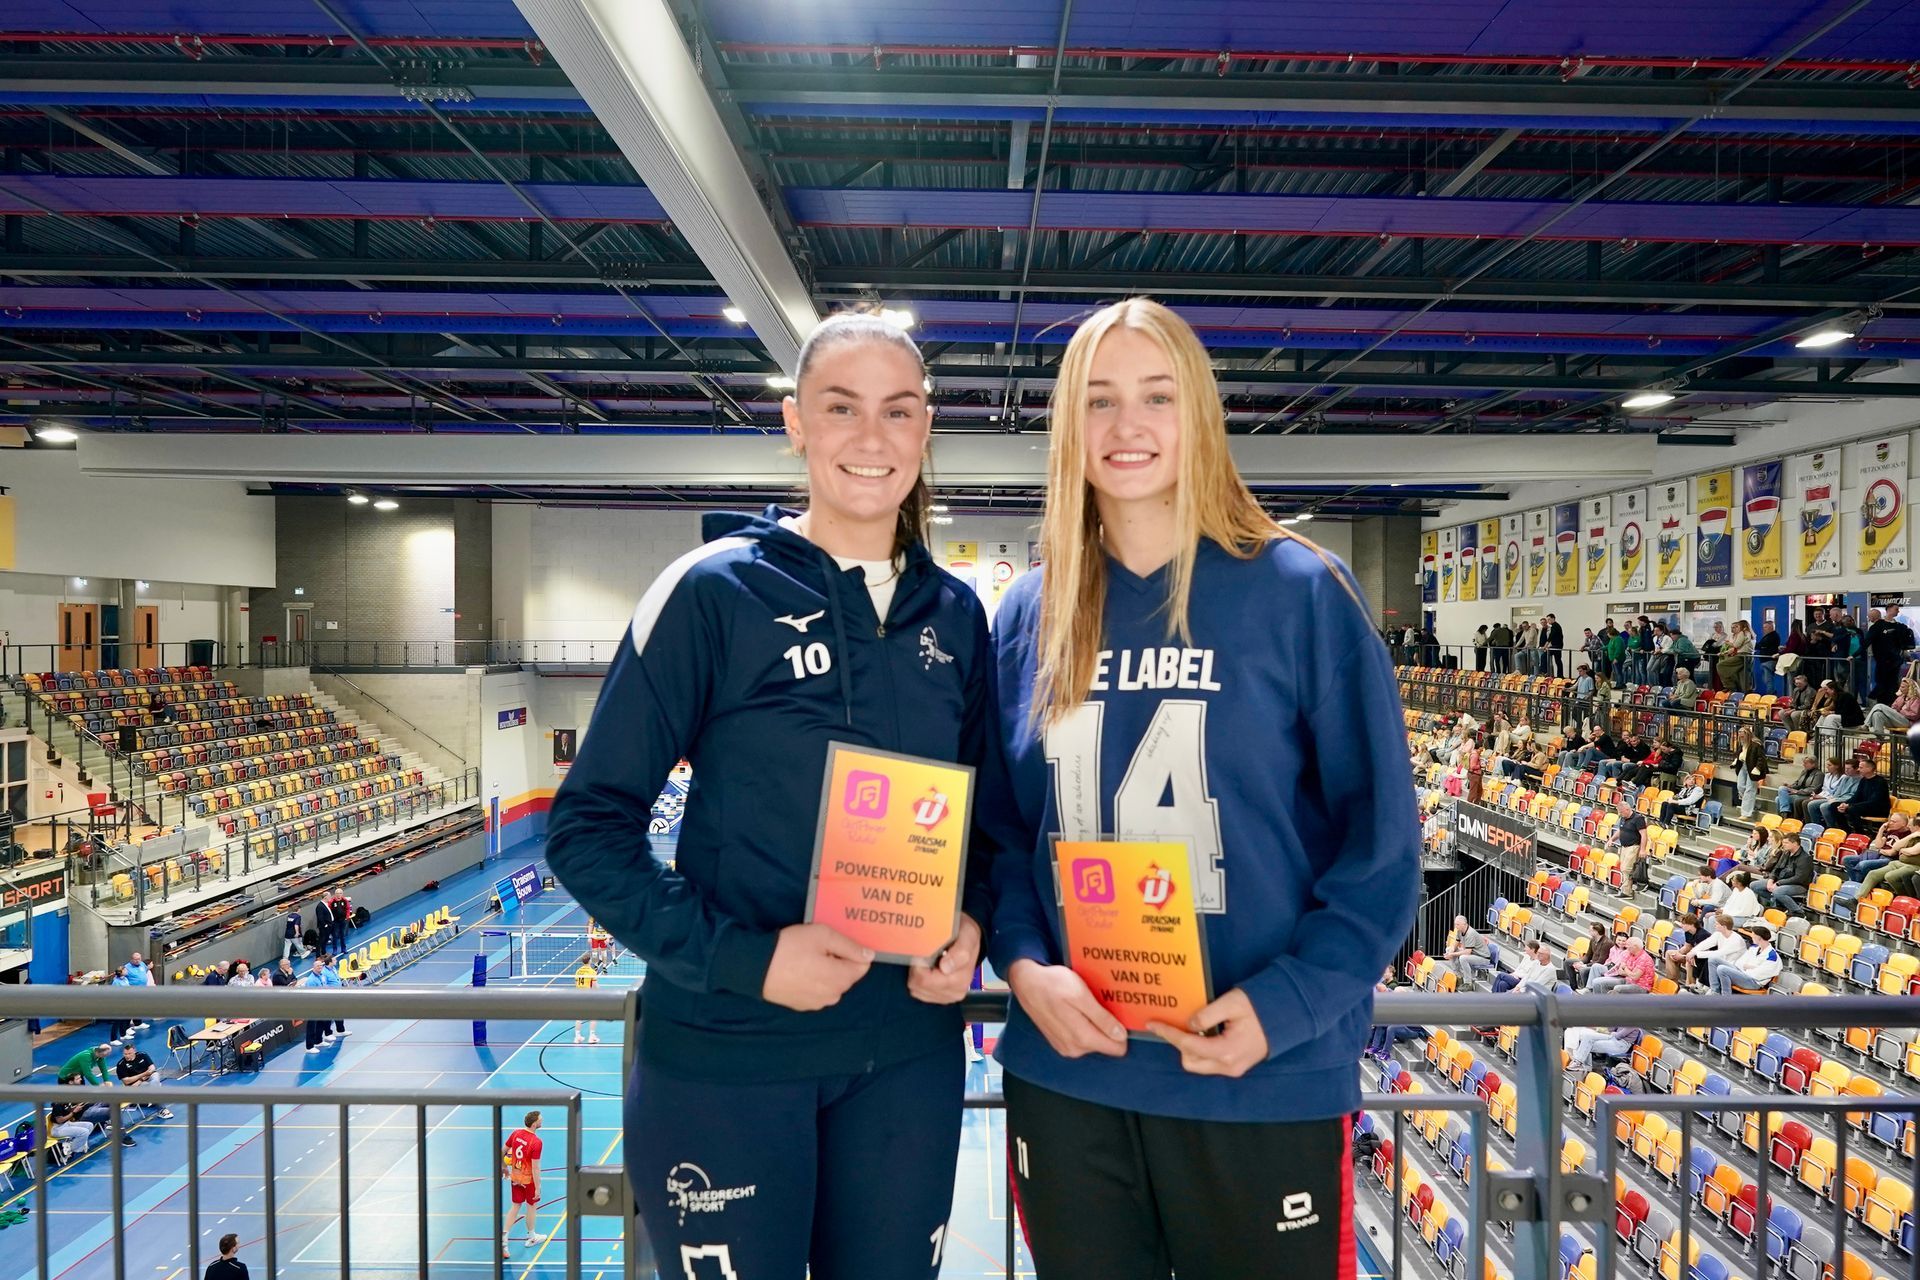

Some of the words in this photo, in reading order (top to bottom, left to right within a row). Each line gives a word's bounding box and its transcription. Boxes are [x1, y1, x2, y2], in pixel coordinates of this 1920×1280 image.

[1808, 559, 1828, 571] 2007
[1871, 557, 1893, 569] 2008
[1705, 572, 1721, 583] 2003
[783, 641, 832, 680] 10
[1117, 647, 1221, 692] LABEL
[1043, 698, 1227, 915] 14
[1458, 813, 1532, 860] OMNISPORT
[512, 870, 536, 889] Draisma
[835, 860, 944, 888] POWERVROUW
[516, 883, 533, 900] Bouw
[862, 886, 891, 903] VAN
[895, 891, 914, 906] DE
[845, 907, 925, 929] WEDSTRIJD
[1082, 946, 1187, 967] POWERVROUW
[1111, 969, 1140, 984] VAN
[1144, 972, 1162, 986] DE
[1101, 988, 1178, 1009] WEDSTRIJD
[515, 1145, 524, 1159] 6
[687, 1184, 757, 1203] SLIEDRECHT
[689, 1200, 726, 1214] SPORT
